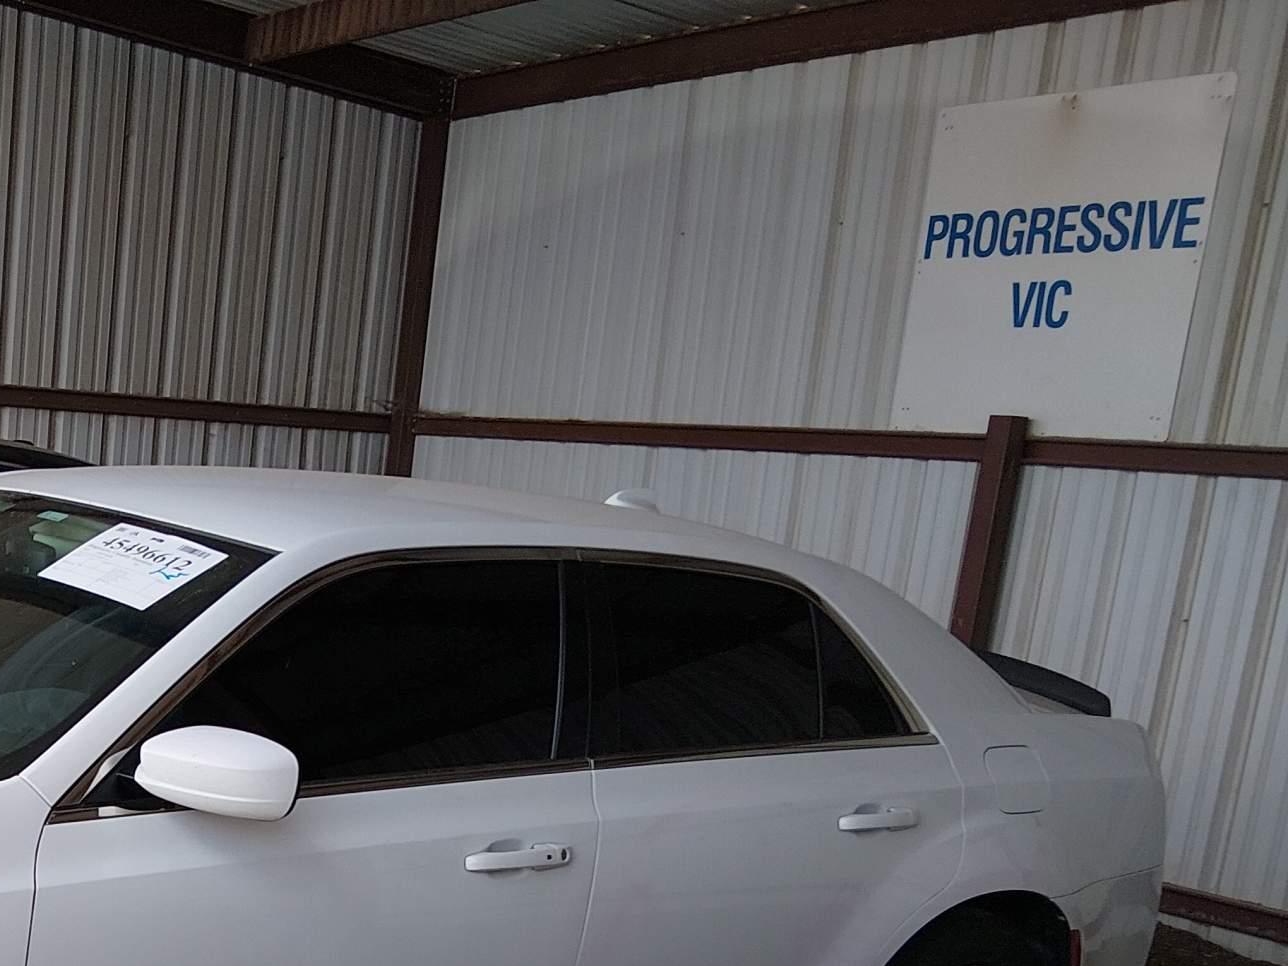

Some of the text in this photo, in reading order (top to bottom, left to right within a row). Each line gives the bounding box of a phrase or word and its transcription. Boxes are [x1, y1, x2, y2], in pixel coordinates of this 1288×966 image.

[923, 196, 1206, 260] PROGRESSIVE
[1012, 279, 1073, 329] VIC
[102, 537, 193, 571] 45496612
